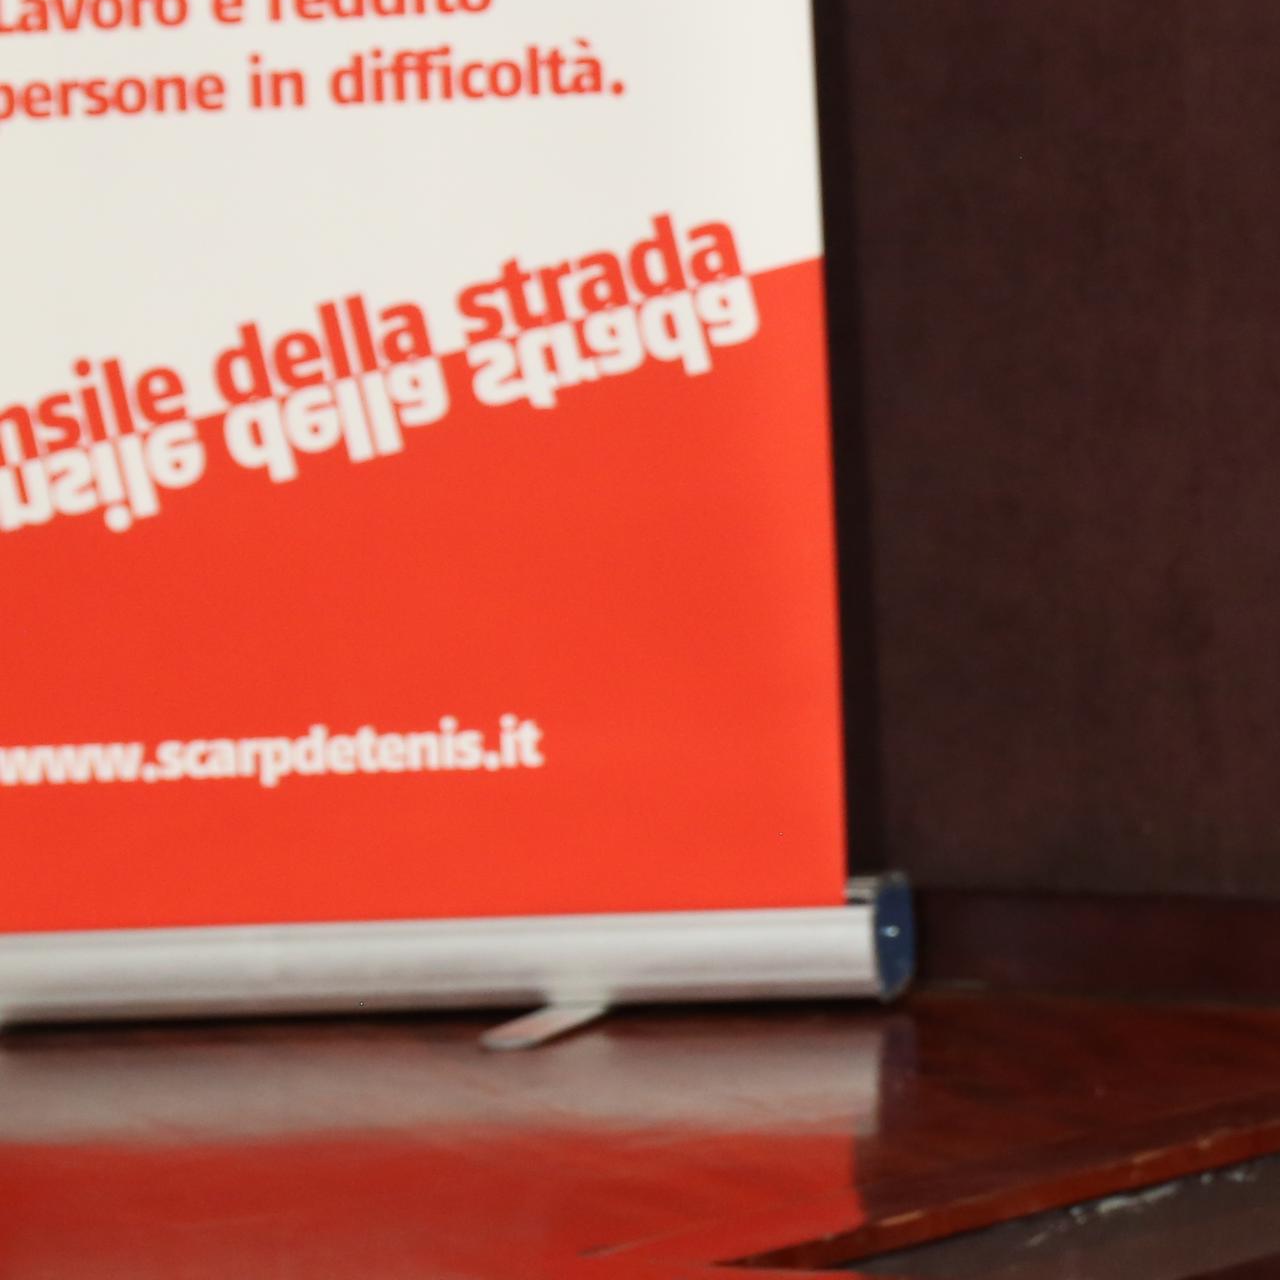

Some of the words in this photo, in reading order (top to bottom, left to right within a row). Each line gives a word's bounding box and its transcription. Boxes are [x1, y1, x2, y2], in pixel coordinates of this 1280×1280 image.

[249, 54, 306, 109] in
[330, 39, 625, 107] difficoltà.
[213, 294, 435, 405] della
[456, 212, 743, 345] strada
[0, 713, 545, 788] www.scarpdetenis.it
